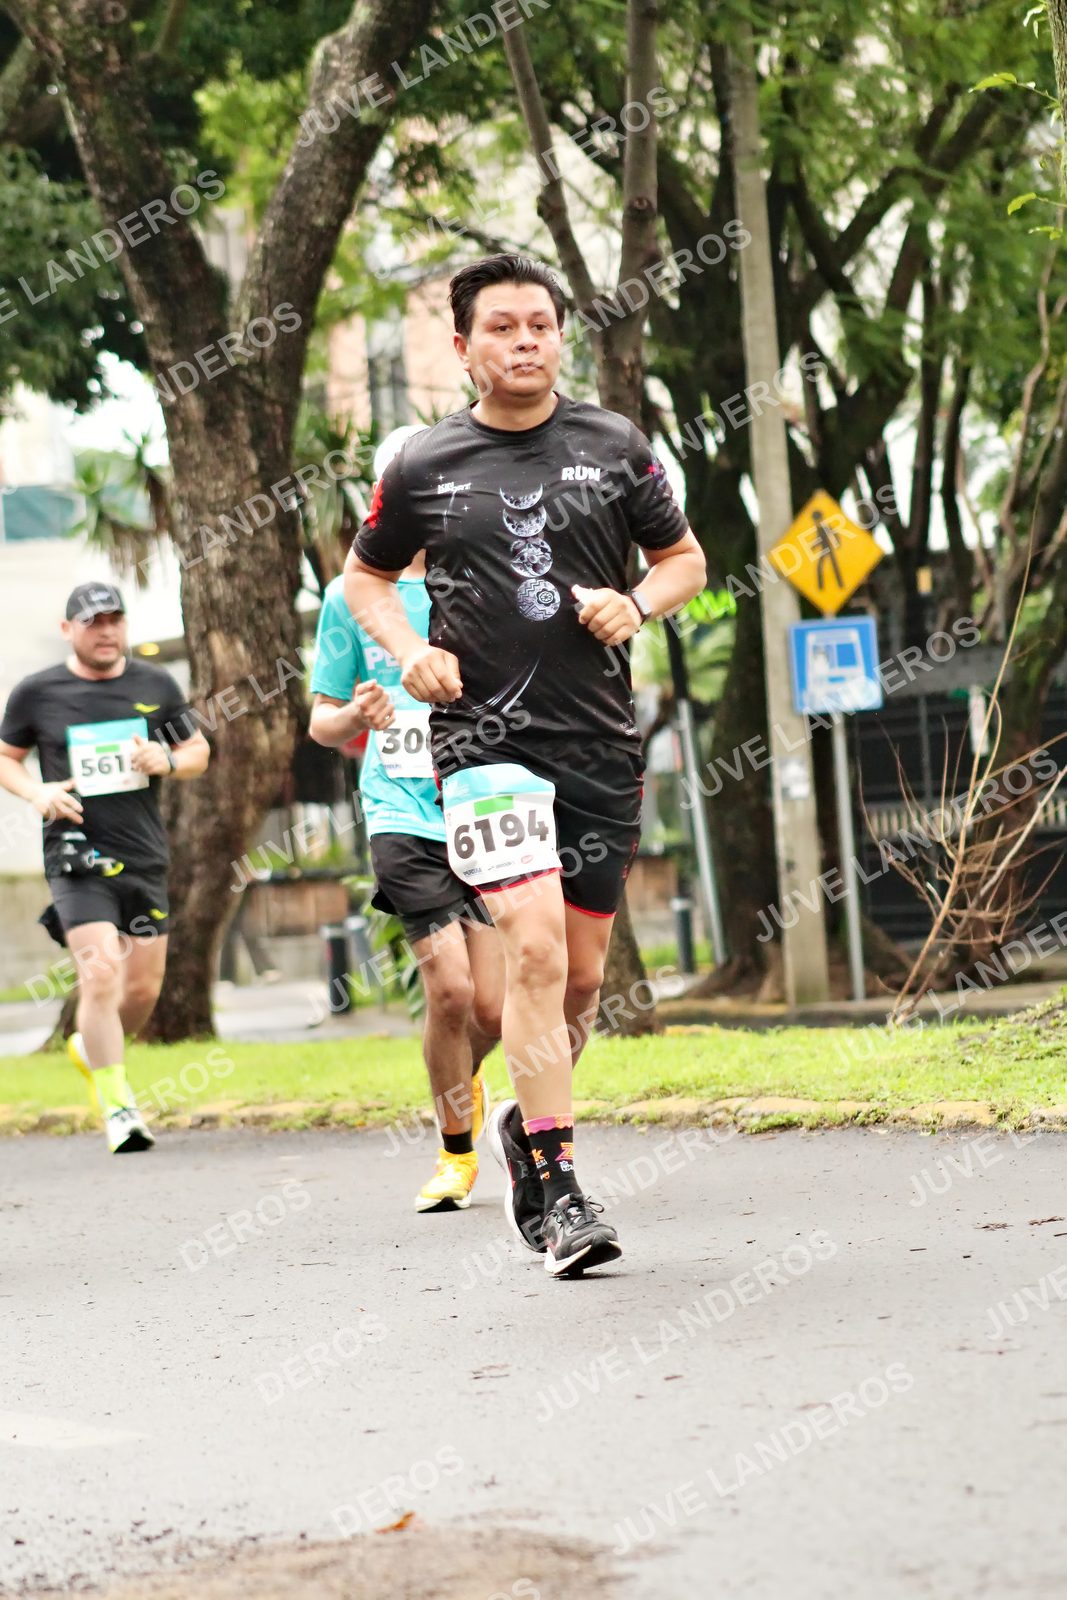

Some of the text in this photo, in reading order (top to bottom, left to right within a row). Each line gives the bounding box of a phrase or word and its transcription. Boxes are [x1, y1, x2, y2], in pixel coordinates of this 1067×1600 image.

[561, 465, 600, 481] RUN
[380, 727, 432, 754] 30
[81, 754, 139, 777] 561
[454, 809, 549, 859] 6194
